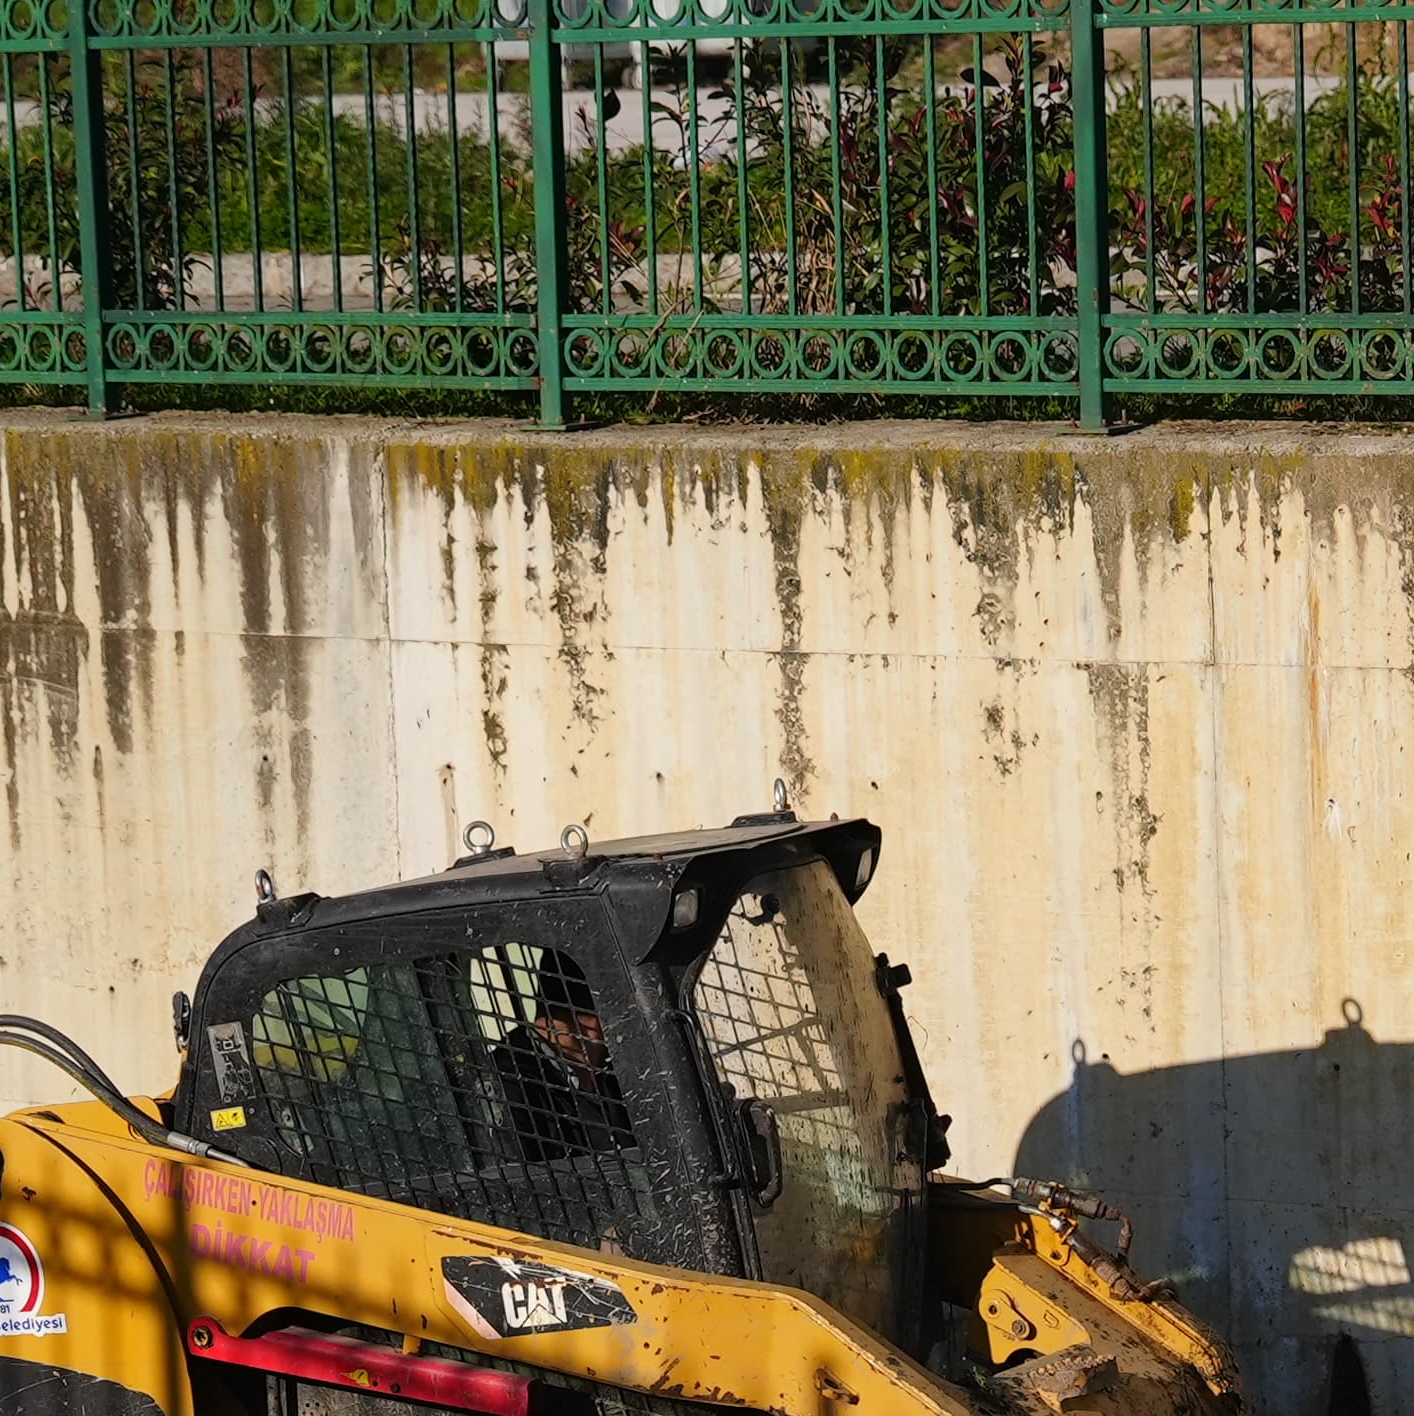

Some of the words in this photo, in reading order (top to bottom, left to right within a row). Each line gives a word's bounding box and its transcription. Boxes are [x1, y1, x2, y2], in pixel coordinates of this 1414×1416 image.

[144, 1158, 252, 1217] ÇALIŞIRKEN
[259, 1186, 356, 1244] YAKLAŞMA
[191, 1219, 316, 1285] DİKKAT
[501, 1277, 568, 1328] CAT
